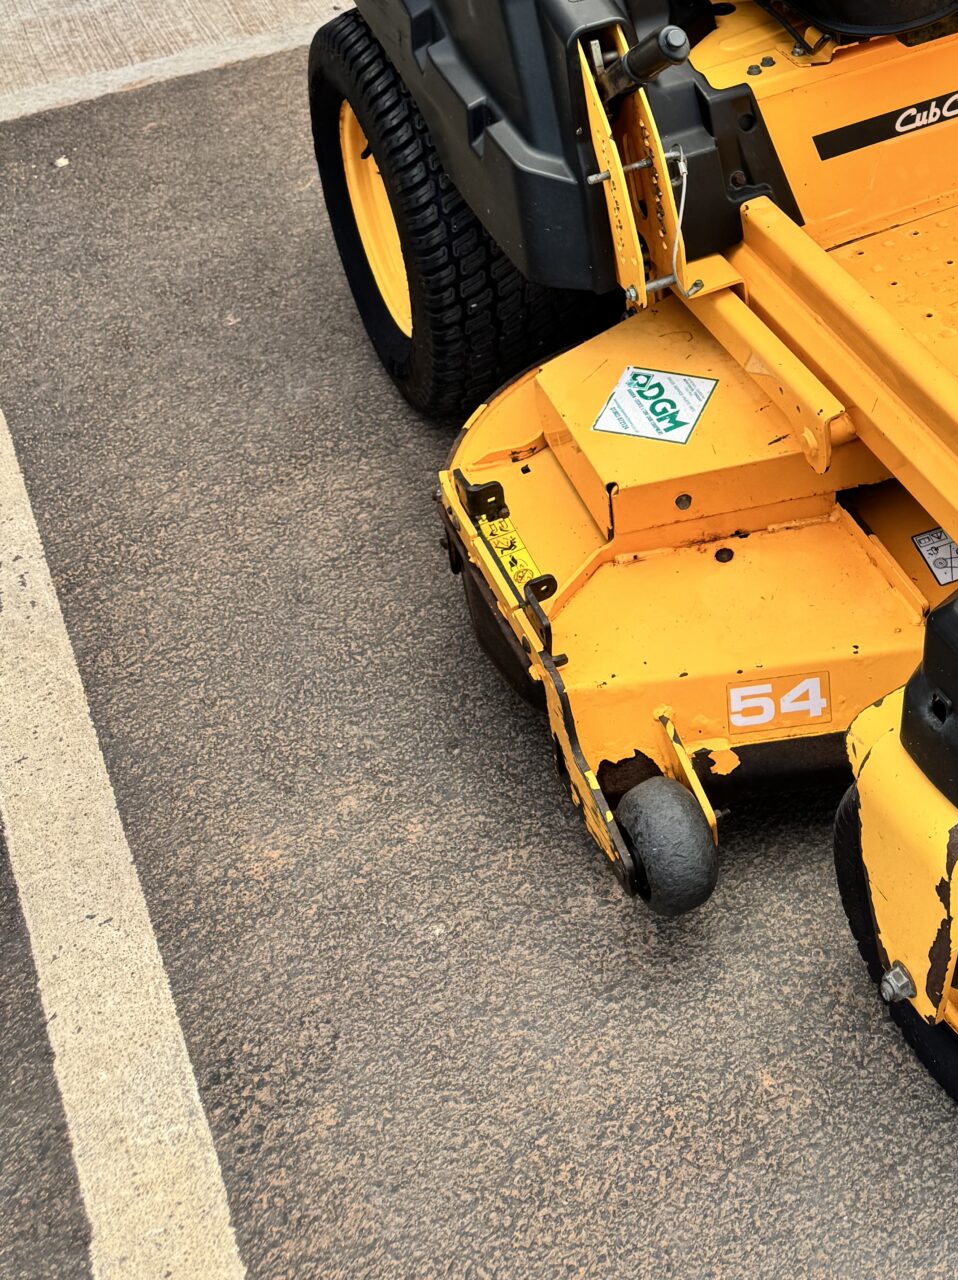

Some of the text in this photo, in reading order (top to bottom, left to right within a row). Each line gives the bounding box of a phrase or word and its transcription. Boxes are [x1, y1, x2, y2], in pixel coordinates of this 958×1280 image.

[895, 100, 941, 132] Cub
[636, 381, 691, 433] DGM
[730, 677, 827, 727] 54
